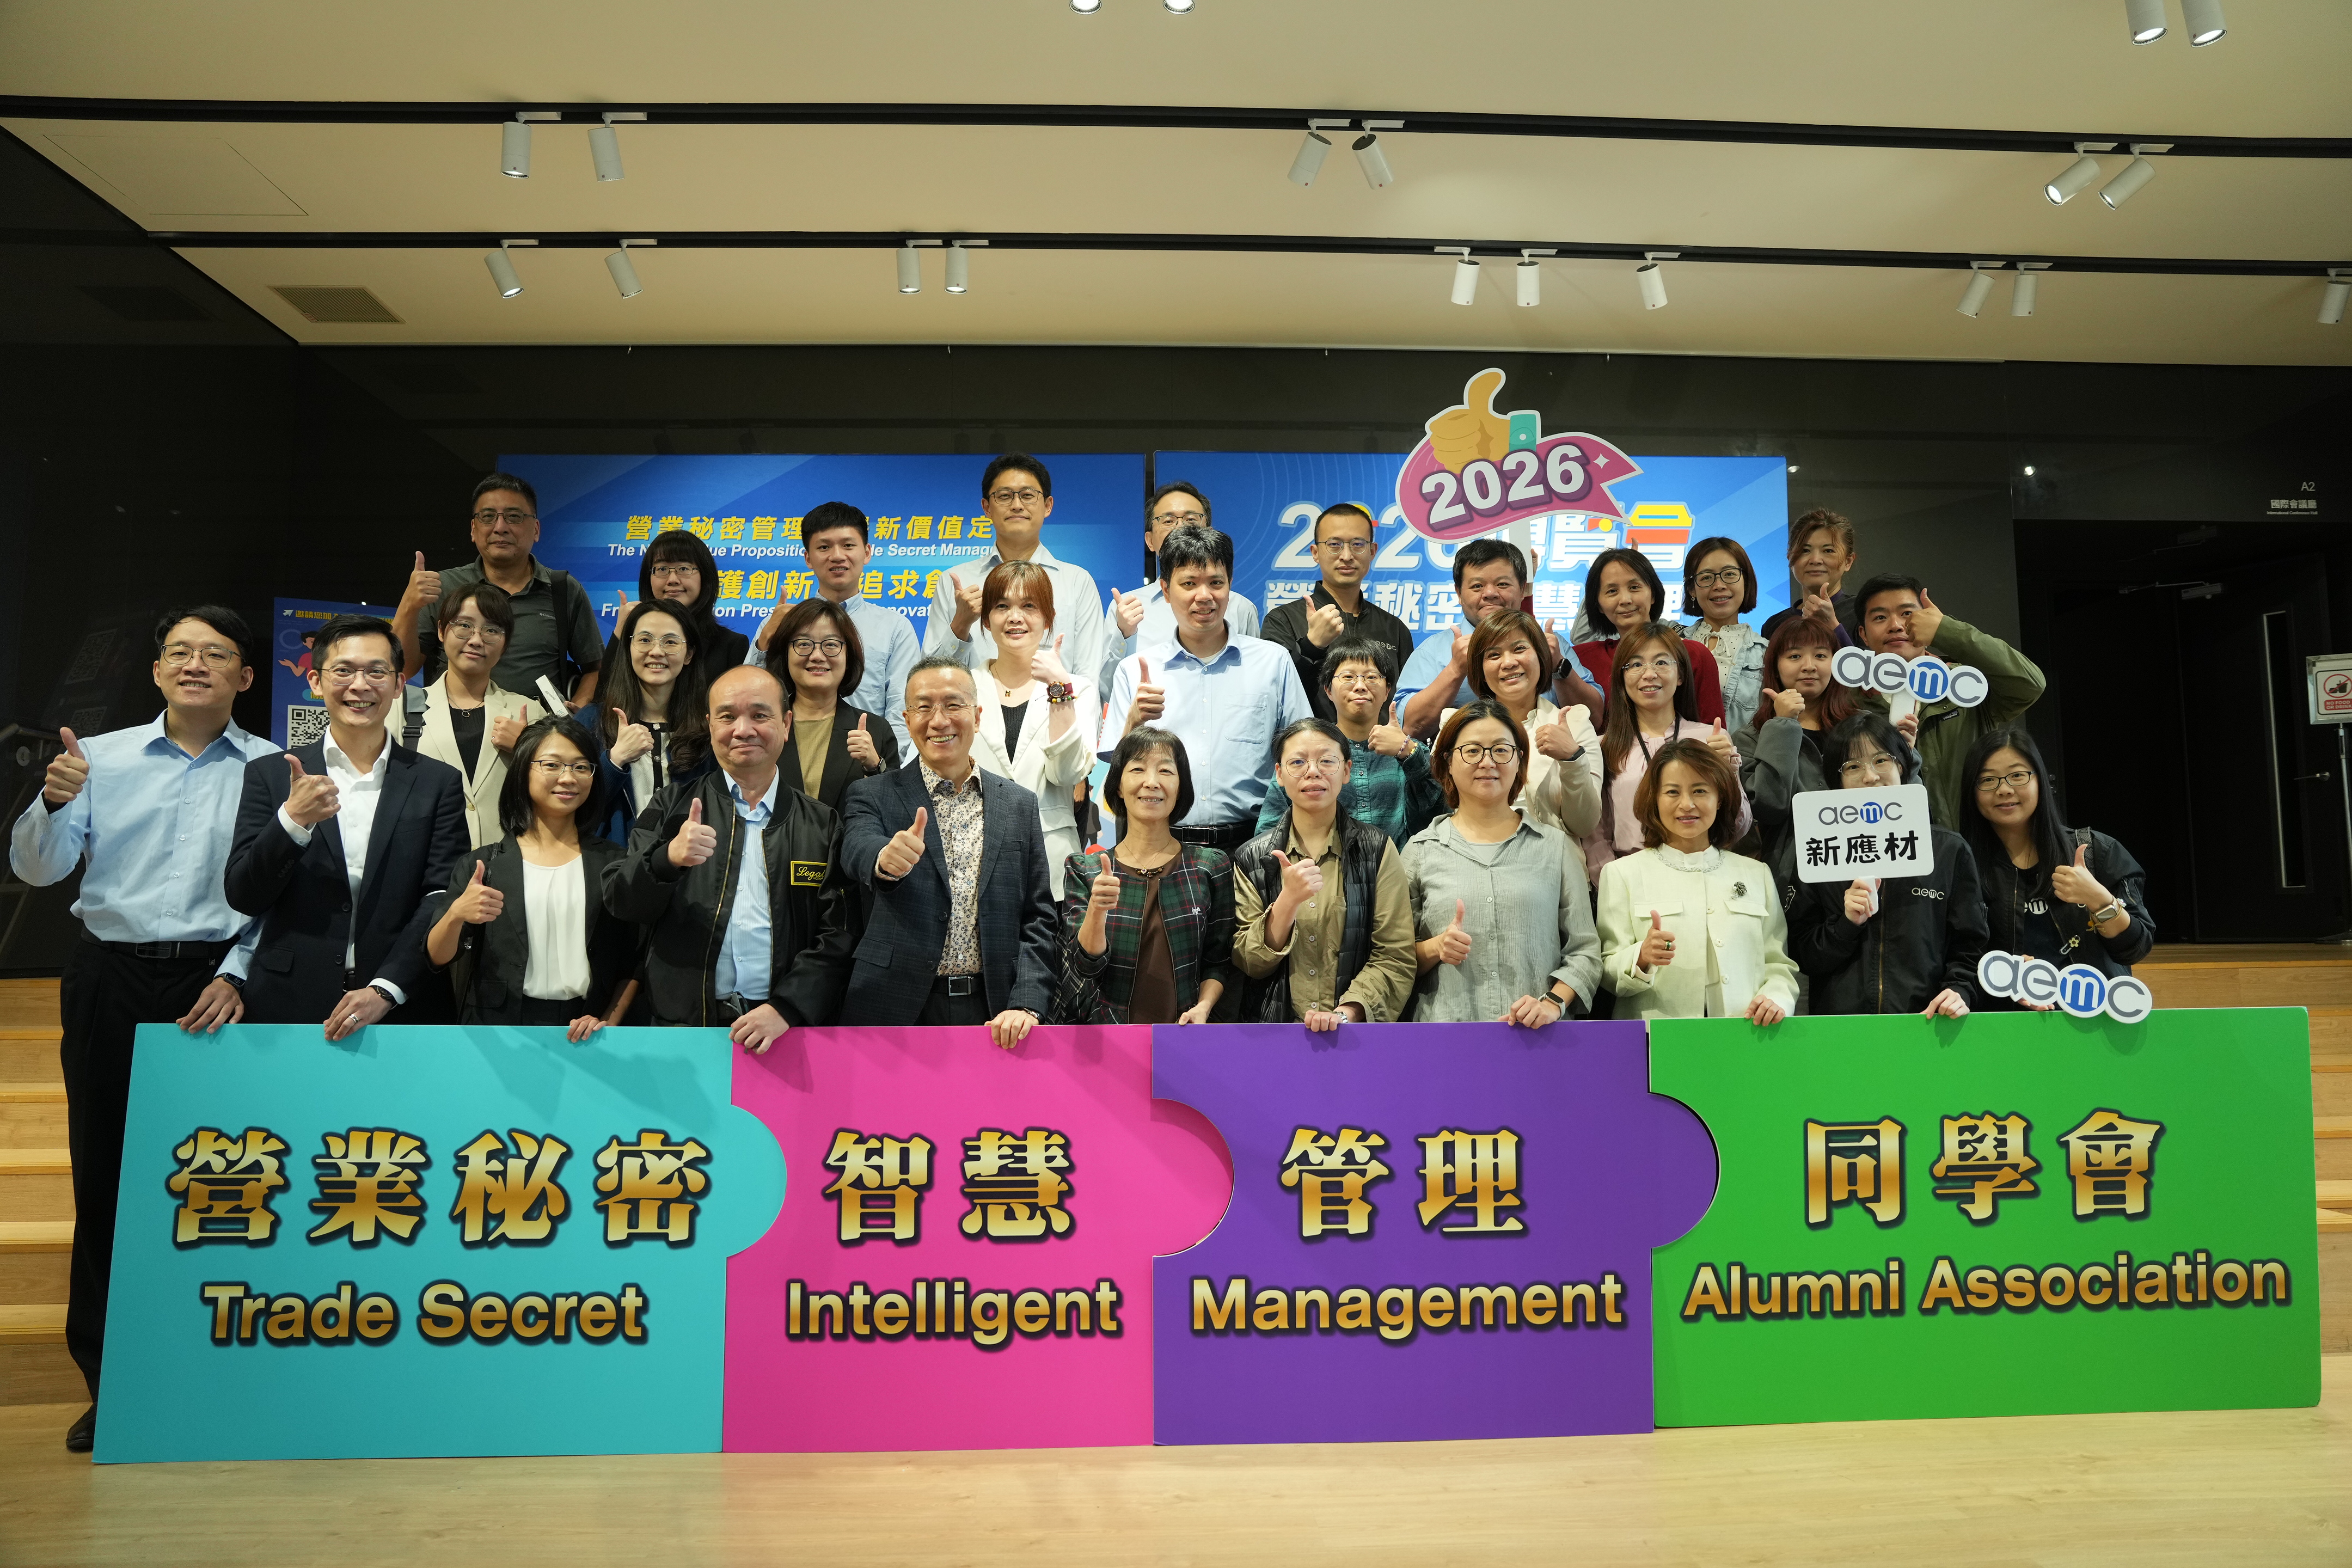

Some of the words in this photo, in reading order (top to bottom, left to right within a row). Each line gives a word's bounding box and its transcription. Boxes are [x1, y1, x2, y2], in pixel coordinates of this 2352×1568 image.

[1422, 444, 1585, 524] 2026
[2301, 482, 2316, 491] A2
[608, 544, 635, 556] The
[887, 544, 936, 556] Secret
[1836, 651, 1984, 705] aemc
[1818, 801, 1903, 826] aemc
[796, 866, 825, 881] Legal
[1805, 830, 1919, 867] 新應材
[1911, 887, 1945, 901] aemc
[1983, 954, 2146, 1018] aemc
[168, 1129, 709, 1244] 營業秘密
[822, 1129, 1072, 1241] 智慧
[1279, 1127, 1524, 1238] 管理
[1805, 1110, 2163, 1224] 同學會
[203, 1284, 395, 1340] Trade
[420, 1282, 644, 1340] Secret
[788, 1280, 1118, 1346] Intelligent
[1191, 1273, 1624, 1342] Management
[1682, 1259, 1901, 1316] Alumni
[1920, 1252, 2287, 1309] Association
